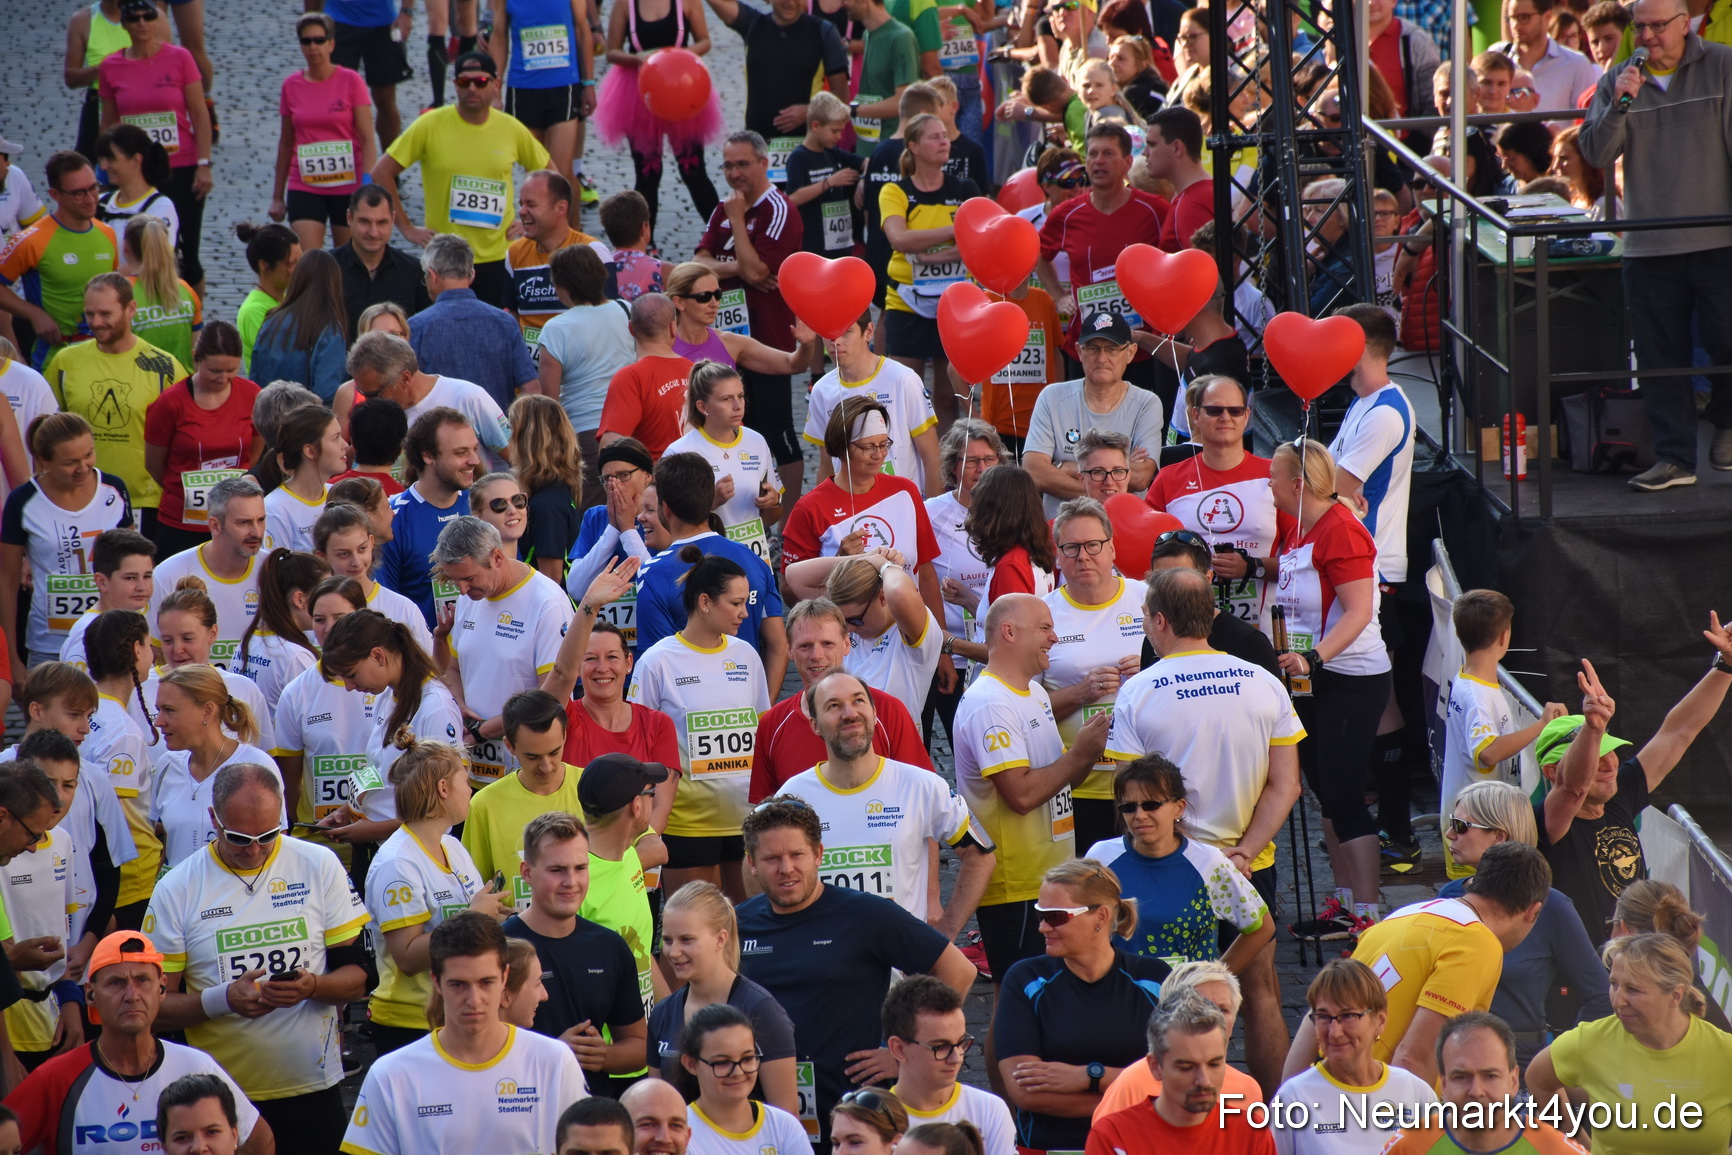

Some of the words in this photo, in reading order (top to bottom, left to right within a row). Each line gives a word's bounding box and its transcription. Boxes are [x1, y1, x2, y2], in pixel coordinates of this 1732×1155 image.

[528, 40, 565, 56] 2015
[944, 40, 973, 56] 2348
[149, 130, 173, 144] 30
[304, 145, 347, 156] BOCK
[305, 157, 347, 173] 5131
[459, 179, 500, 194] BOCK
[456, 192, 500, 212] 2831
[918, 262, 961, 278] 2607
[133, 302, 193, 324] BOCK
[998, 367, 1042, 378] JOHANNES
[658, 379, 680, 397] RESCUE
[1236, 541, 1258, 550] HERZ
[499, 614, 512, 626] 20
[1119, 616, 1132, 626] 20
[496, 623, 525, 635] Neumarkter
[495, 631, 519, 641] Stadtlauf
[723, 662, 737, 671] 20
[1152, 677, 1174, 690] 20.
[1175, 667, 1255, 685] Neumarkter
[1176, 682, 1243, 700] Stadtlauf
[694, 712, 752, 728] BOCK
[698, 732, 753, 756] 5109
[986, 731, 1011, 752] 20
[110, 757, 133, 775] 20
[707, 759, 749, 771] ANNIKA
[867, 802, 882, 814] 20
[867, 813, 905, 821] Neumarkter
[867, 821, 898, 829] Stadtlauf
[270, 881, 286, 893] 20
[286, 883, 305, 891] JAHRE
[271, 889, 311, 901] Neumarkter
[387, 886, 413, 907] 20
[272, 897, 305, 909] Stadtlauf
[201, 907, 233, 917] BOCK
[225, 923, 300, 948] BOCK
[230, 947, 302, 981] 5282
[498, 1083, 516, 1095] 20
[517, 1087, 537, 1095] JAHRE
[498, 1096, 541, 1105] Neumarkter
[418, 1105, 453, 1115] BOCK
[498, 1105, 534, 1114] Stadtlauf
